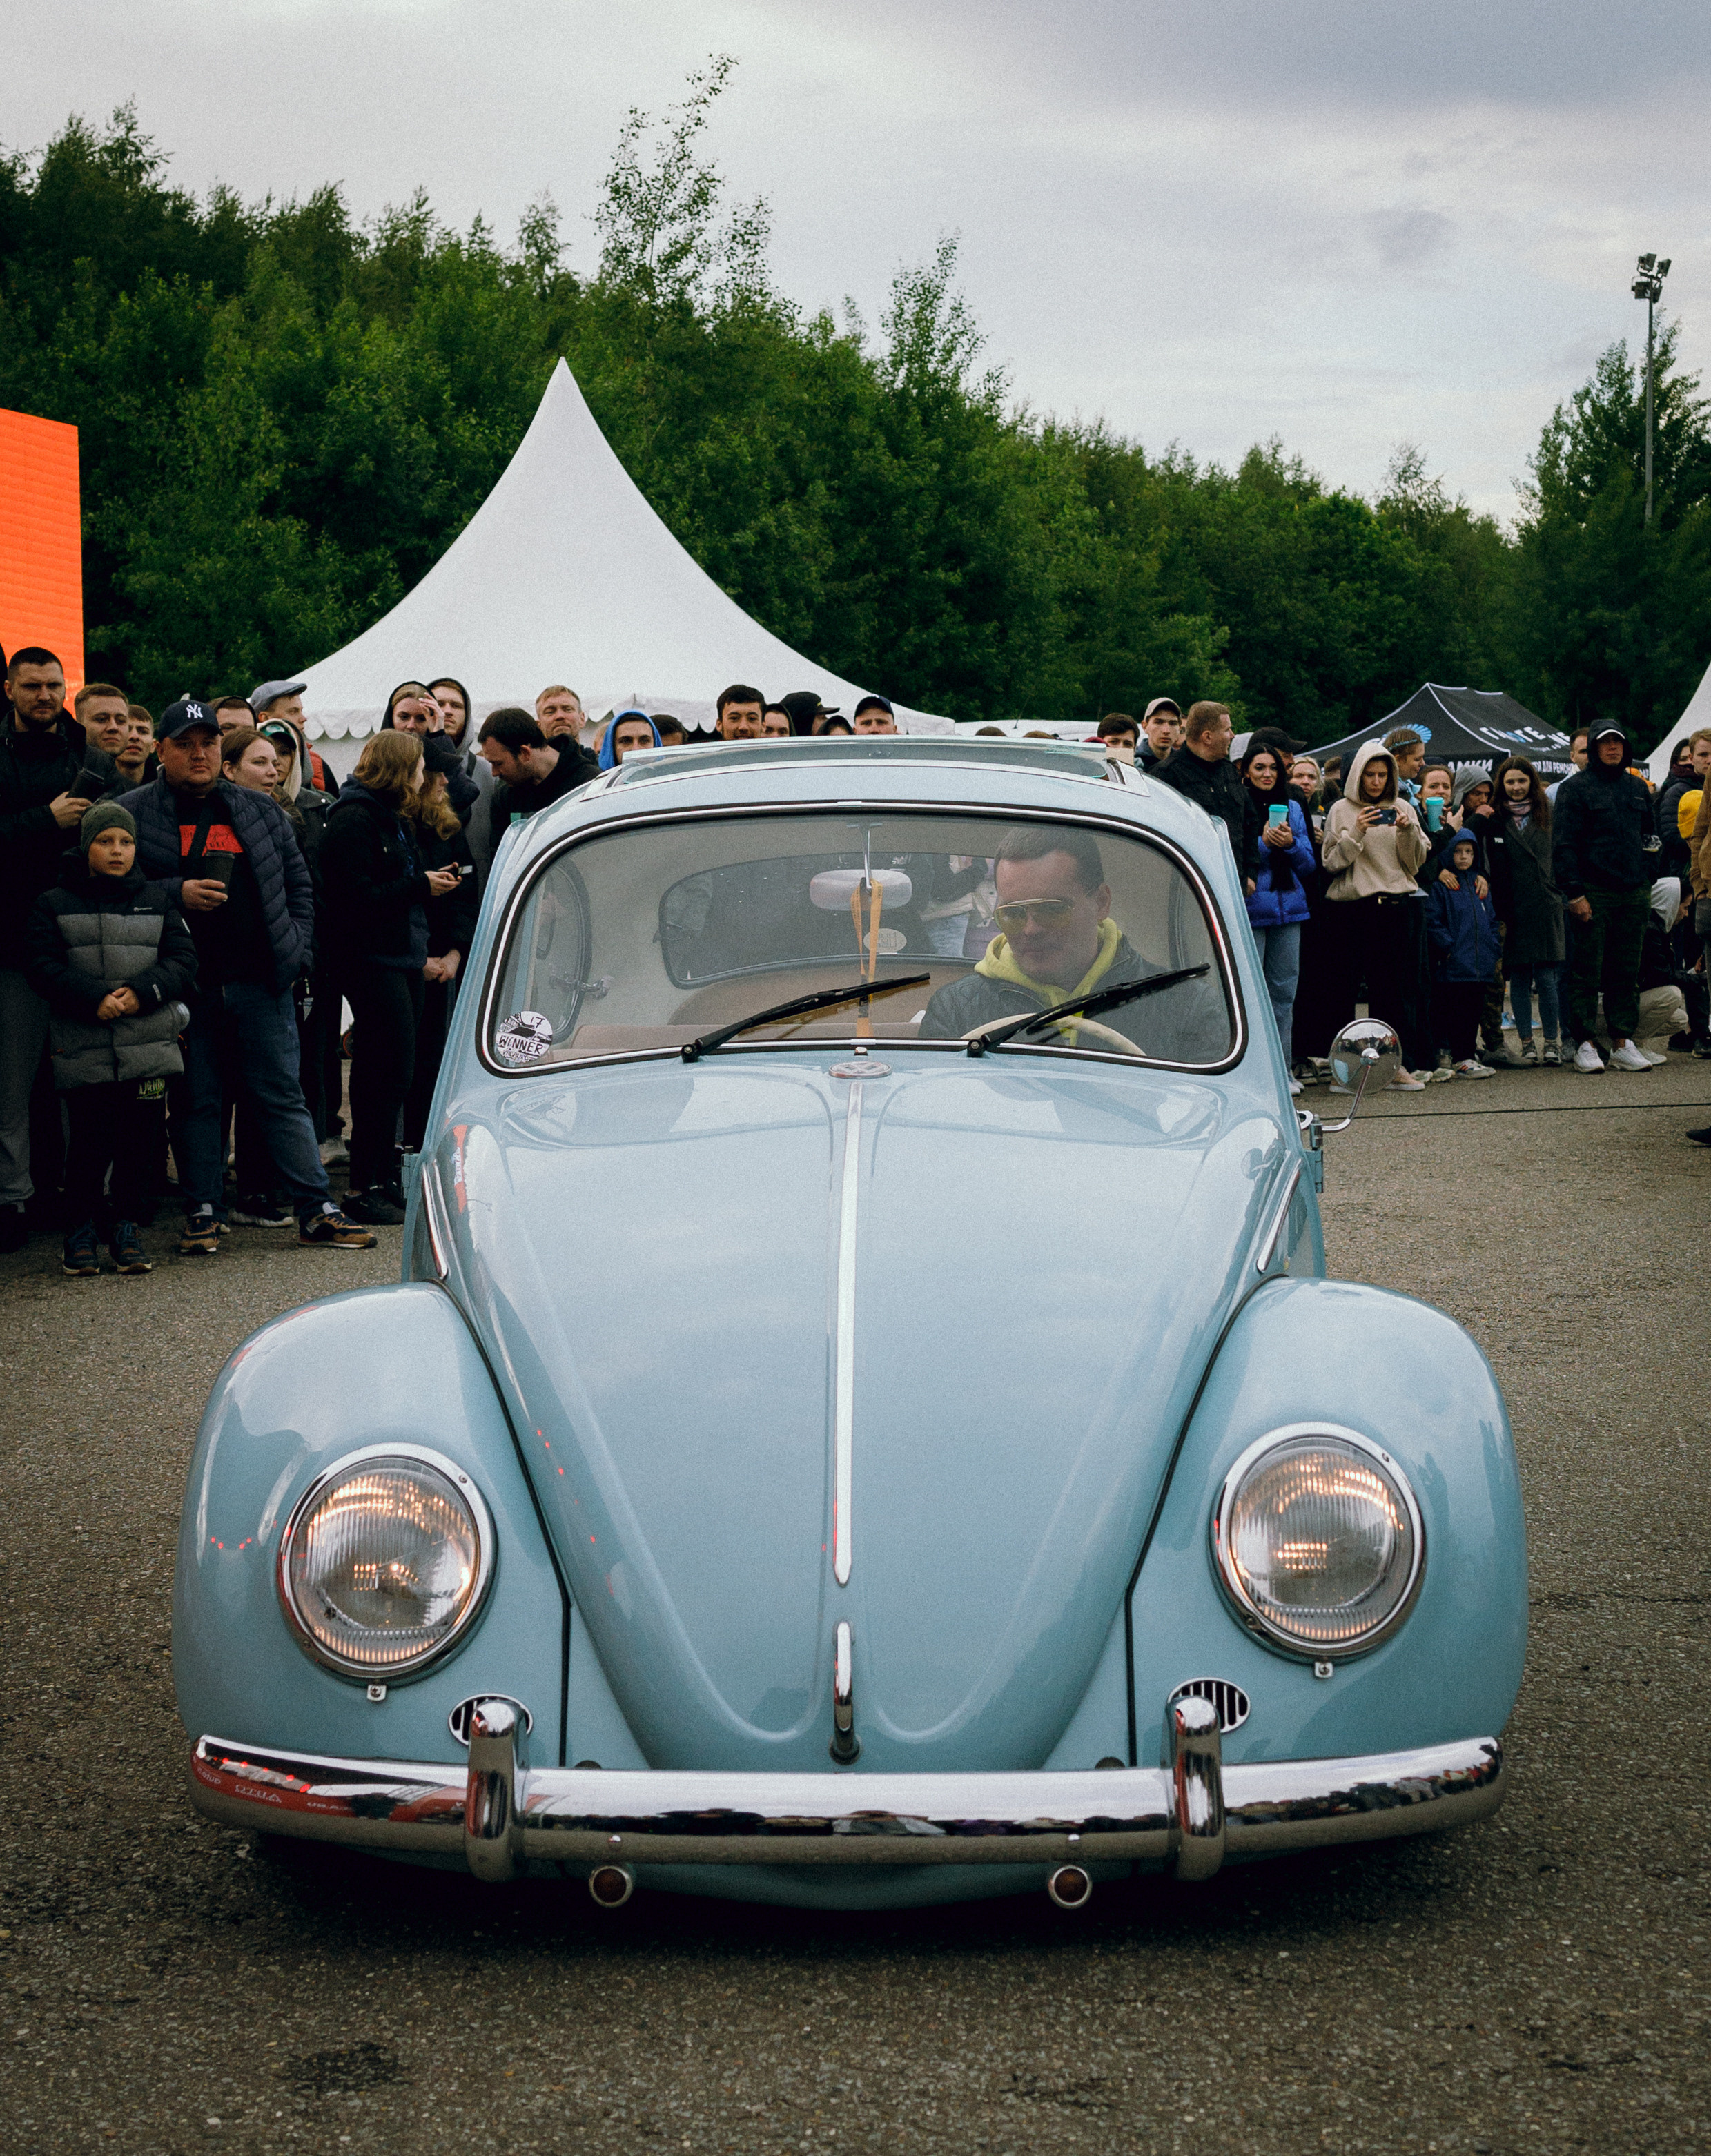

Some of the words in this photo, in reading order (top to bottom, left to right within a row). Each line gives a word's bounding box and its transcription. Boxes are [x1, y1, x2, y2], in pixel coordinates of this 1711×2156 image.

[186, 704, 203, 718] NY
[530, 1016, 545, 1029] 17
[498, 1035, 543, 1055] WINNER
